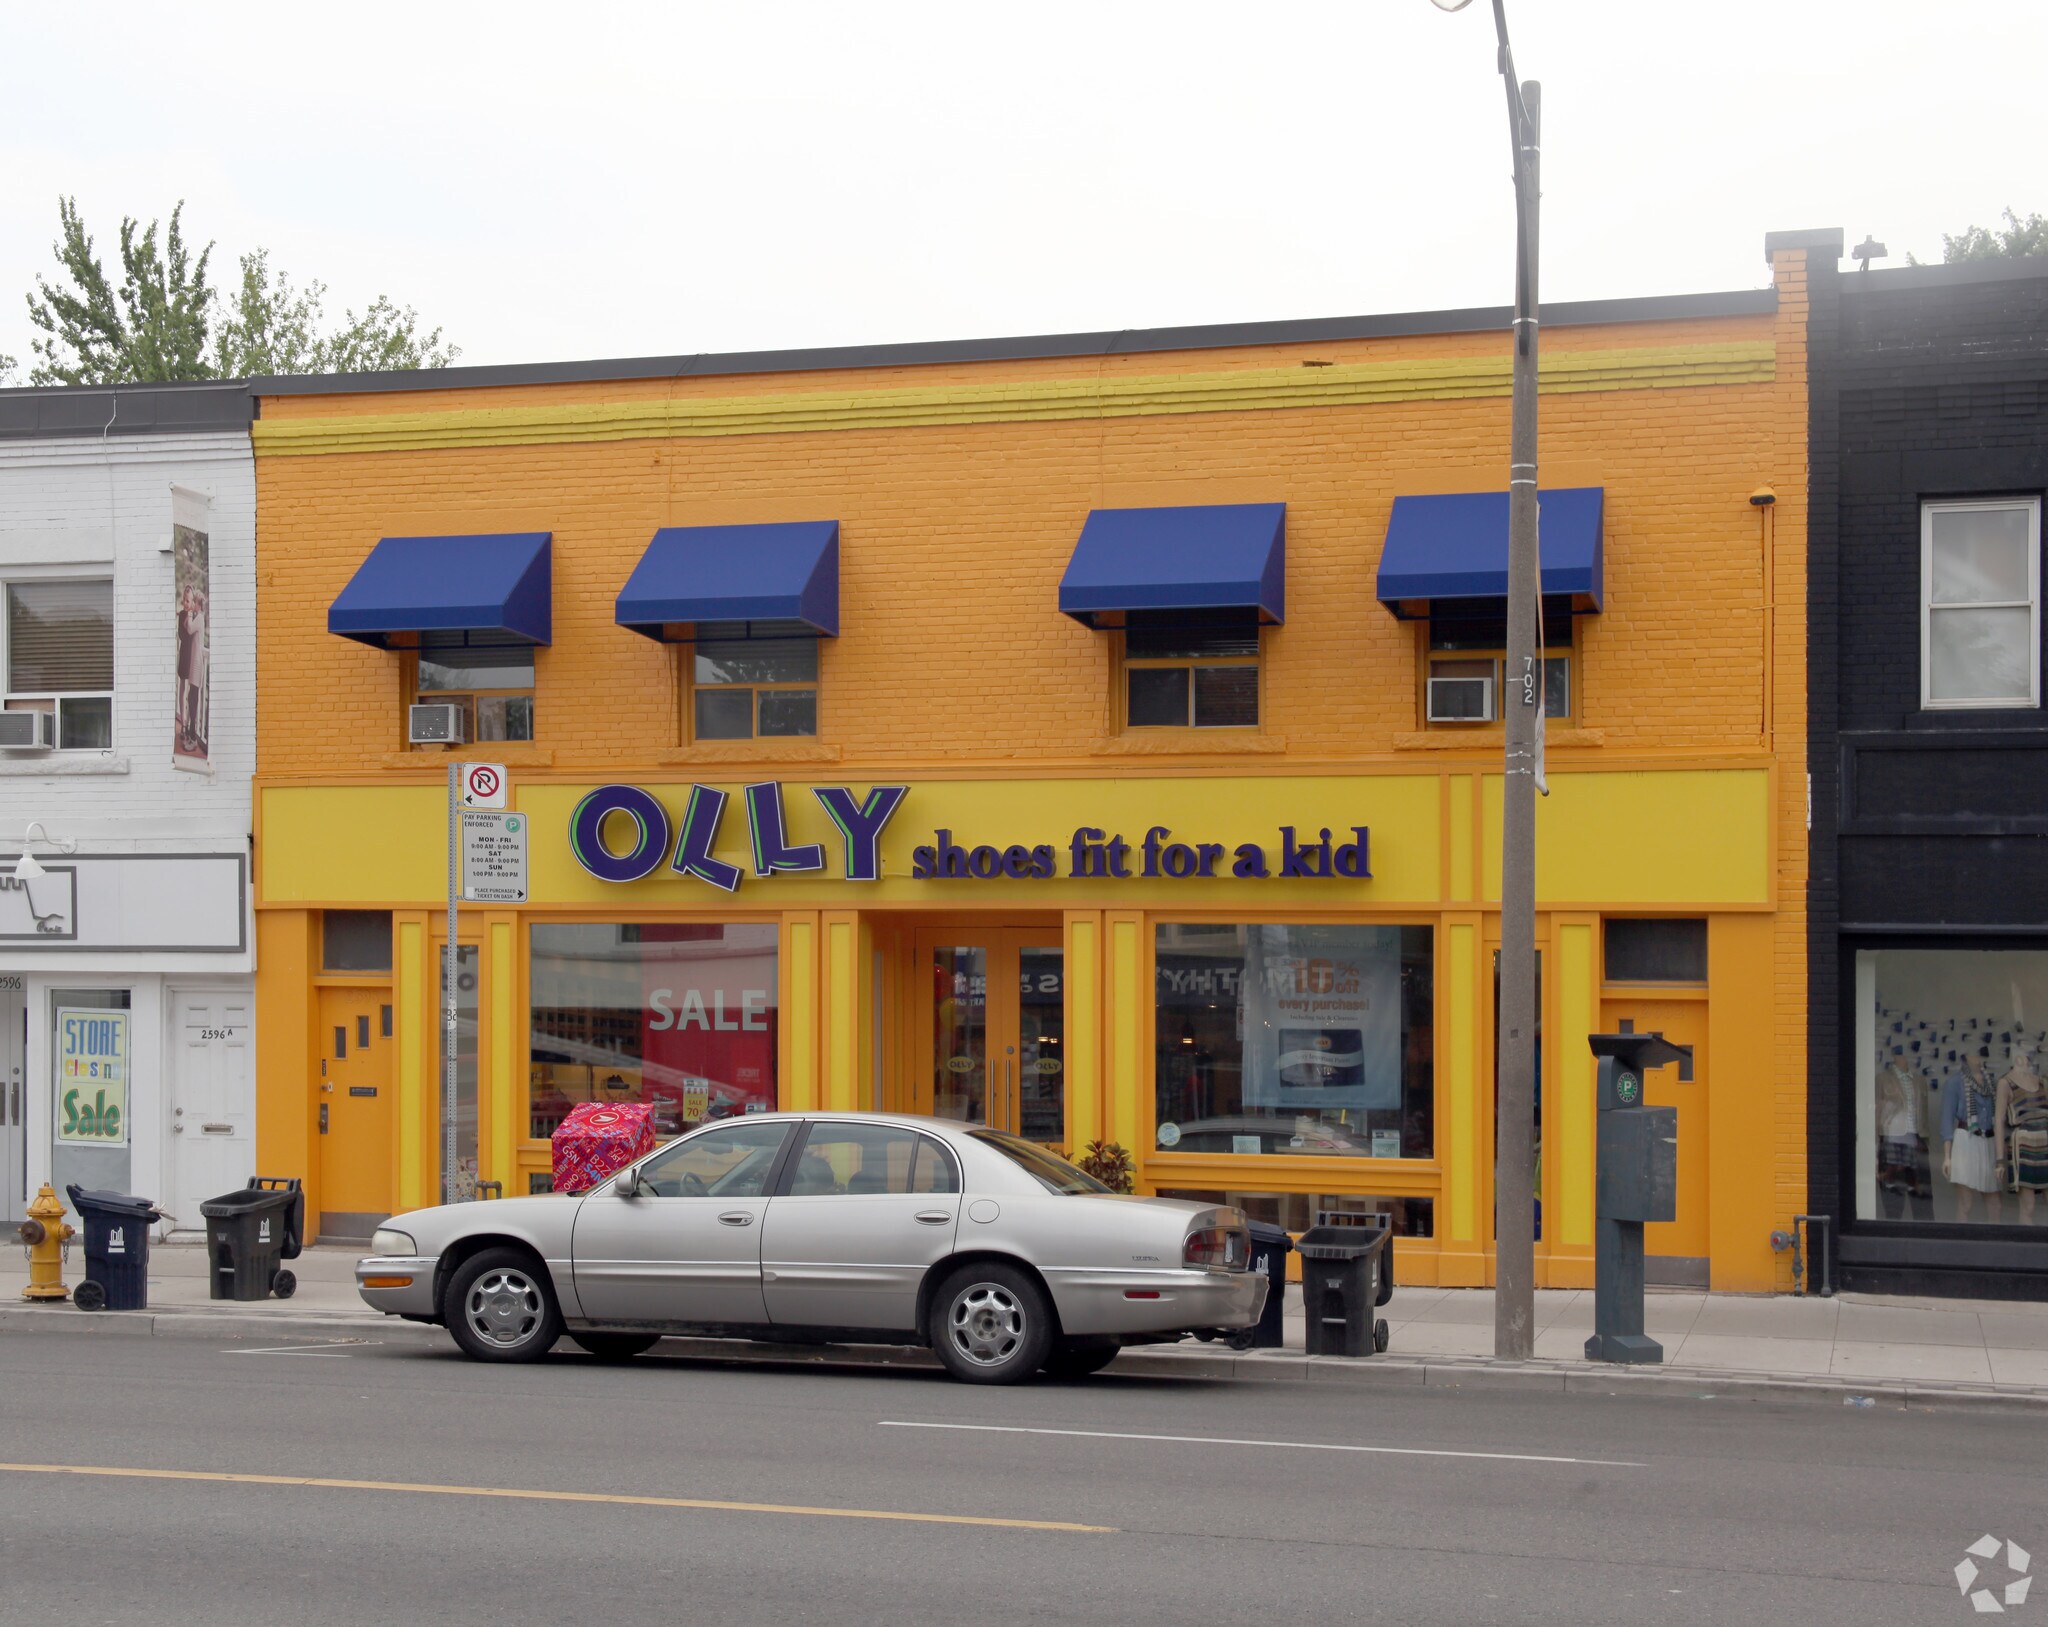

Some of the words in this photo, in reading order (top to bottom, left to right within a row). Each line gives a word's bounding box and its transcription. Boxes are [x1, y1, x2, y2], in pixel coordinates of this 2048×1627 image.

[1524, 656, 1532, 703] 702
[568, 781, 910, 892] OLLY
[912, 828, 1056, 879] shoes
[1068, 827, 1132, 878] fit
[1141, 826, 1225, 878] for
[1232, 843, 1271, 878] a
[1278, 826, 1373, 878] kid
[1290, 956, 1334, 994] 10
[1335, 978, 1359, 993] off
[649, 989, 768, 1031] SALE
[1278, 1000, 1309, 1012] every
[1312, 998, 1370, 1012] purchase!
[66, 1019, 121, 1056] STORE
[202, 1030, 225, 1040] 2596
[65, 1059, 121, 1080] Closing
[1036, 1062, 1060, 1070] OLLY
[63, 1088, 120, 1137] Sale
